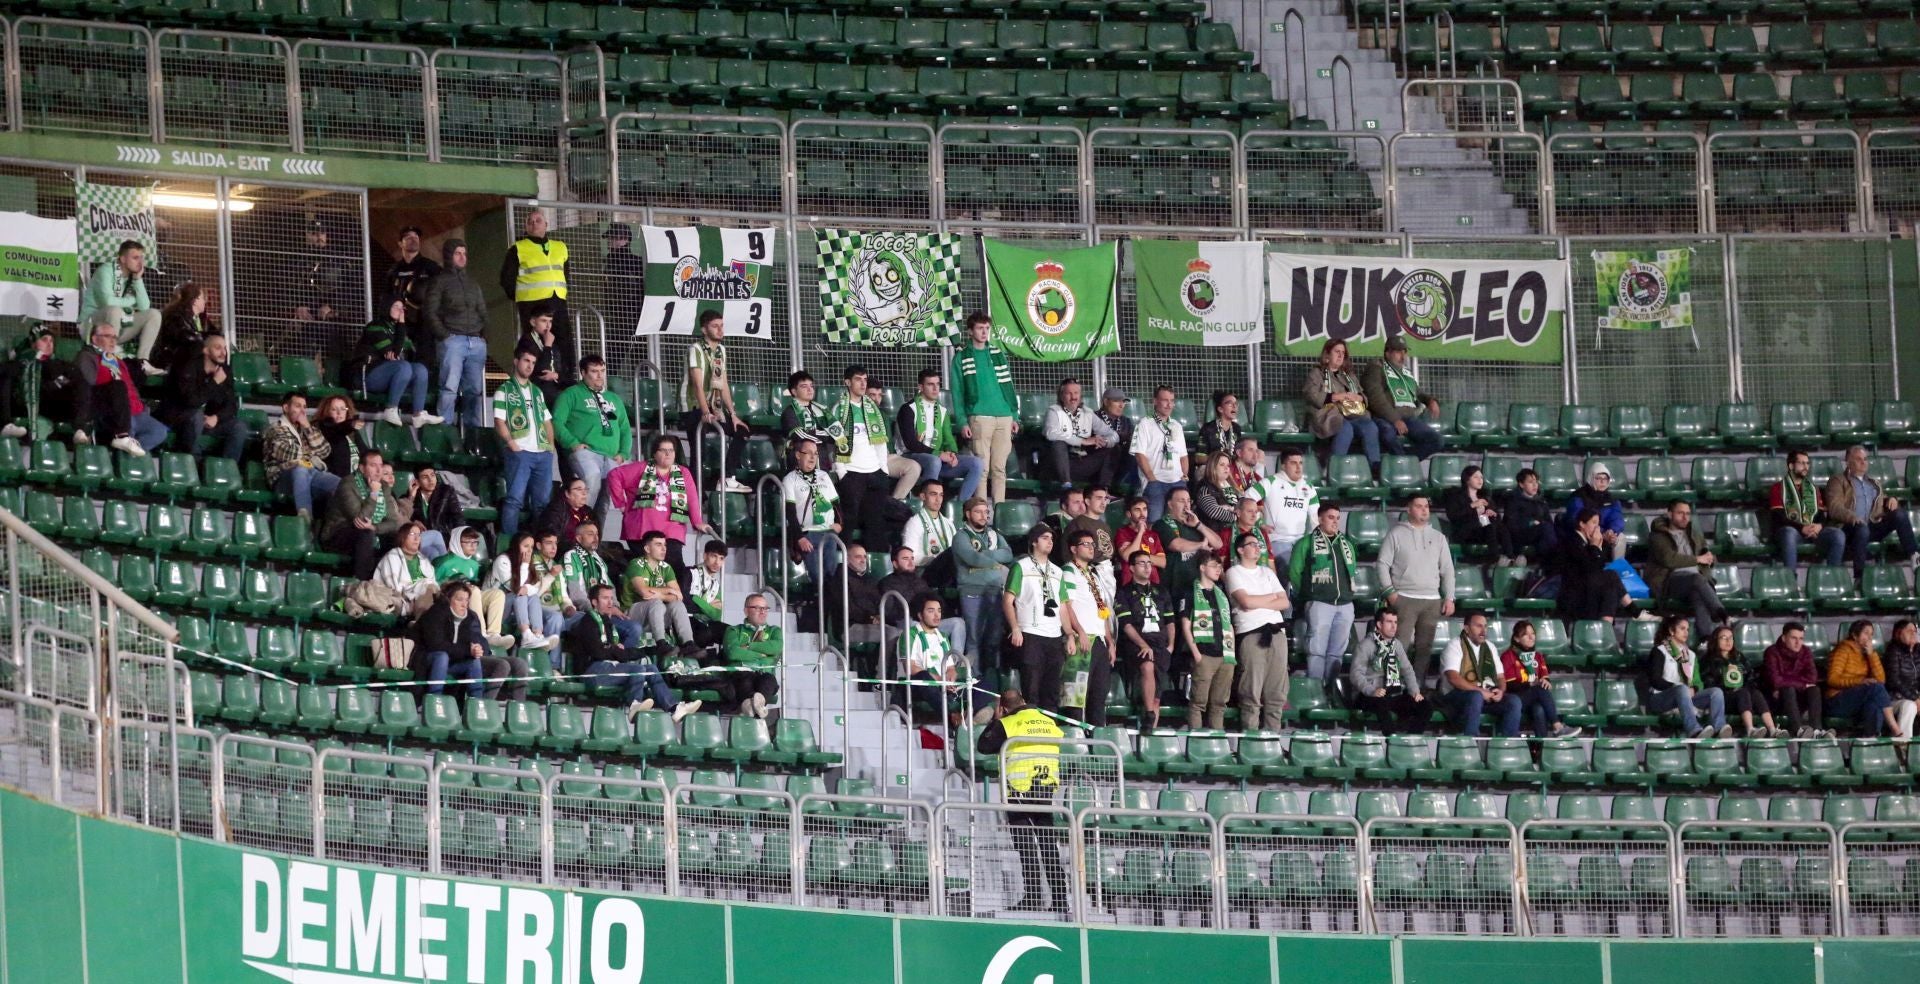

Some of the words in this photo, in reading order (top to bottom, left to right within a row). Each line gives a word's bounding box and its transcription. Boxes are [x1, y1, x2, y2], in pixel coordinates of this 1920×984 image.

[1274, 24, 1284, 32] 15
[1366, 121, 1376, 129] 13
[172, 150, 227, 169] SALIDA
[238, 155, 271, 171] EXIT
[89, 203, 154, 238] CONCANOS
[664, 229, 679, 258] 1
[747, 231, 765, 260] 9
[864, 235, 916, 252] LOCOS
[4, 251, 61, 267] COMUNIDAD
[4, 267, 63, 283] VALENCIANA
[680, 279, 753, 300] CORRALES
[1029, 290, 1038, 307] REAL
[1038, 280, 1062, 289] RACING
[1063, 289, 1075, 307] CLUB
[1182, 280, 1190, 296] REAL
[1189, 273, 1211, 281] RACING
[1211, 280, 1220, 297] CLUB
[1650, 276, 1667, 312] ASTILLERO
[659, 301, 676, 332] 1
[744, 302, 762, 335] 3
[1186, 304, 1217, 316] SANTANDER
[1035, 318, 1069, 333] SANTANDER
[1148, 316, 1178, 331] REAL
[1180, 320, 1223, 333] RACING
[1225, 321, 1257, 333] CLUB
[1416, 326, 1432, 336] 2014
[870, 326, 900, 343] POR
[901, 327, 917, 343] TI
[992, 324, 1028, 348] Real
[1028, 333, 1082, 359] Racing
[242, 853, 645, 984] DEMETRIO
